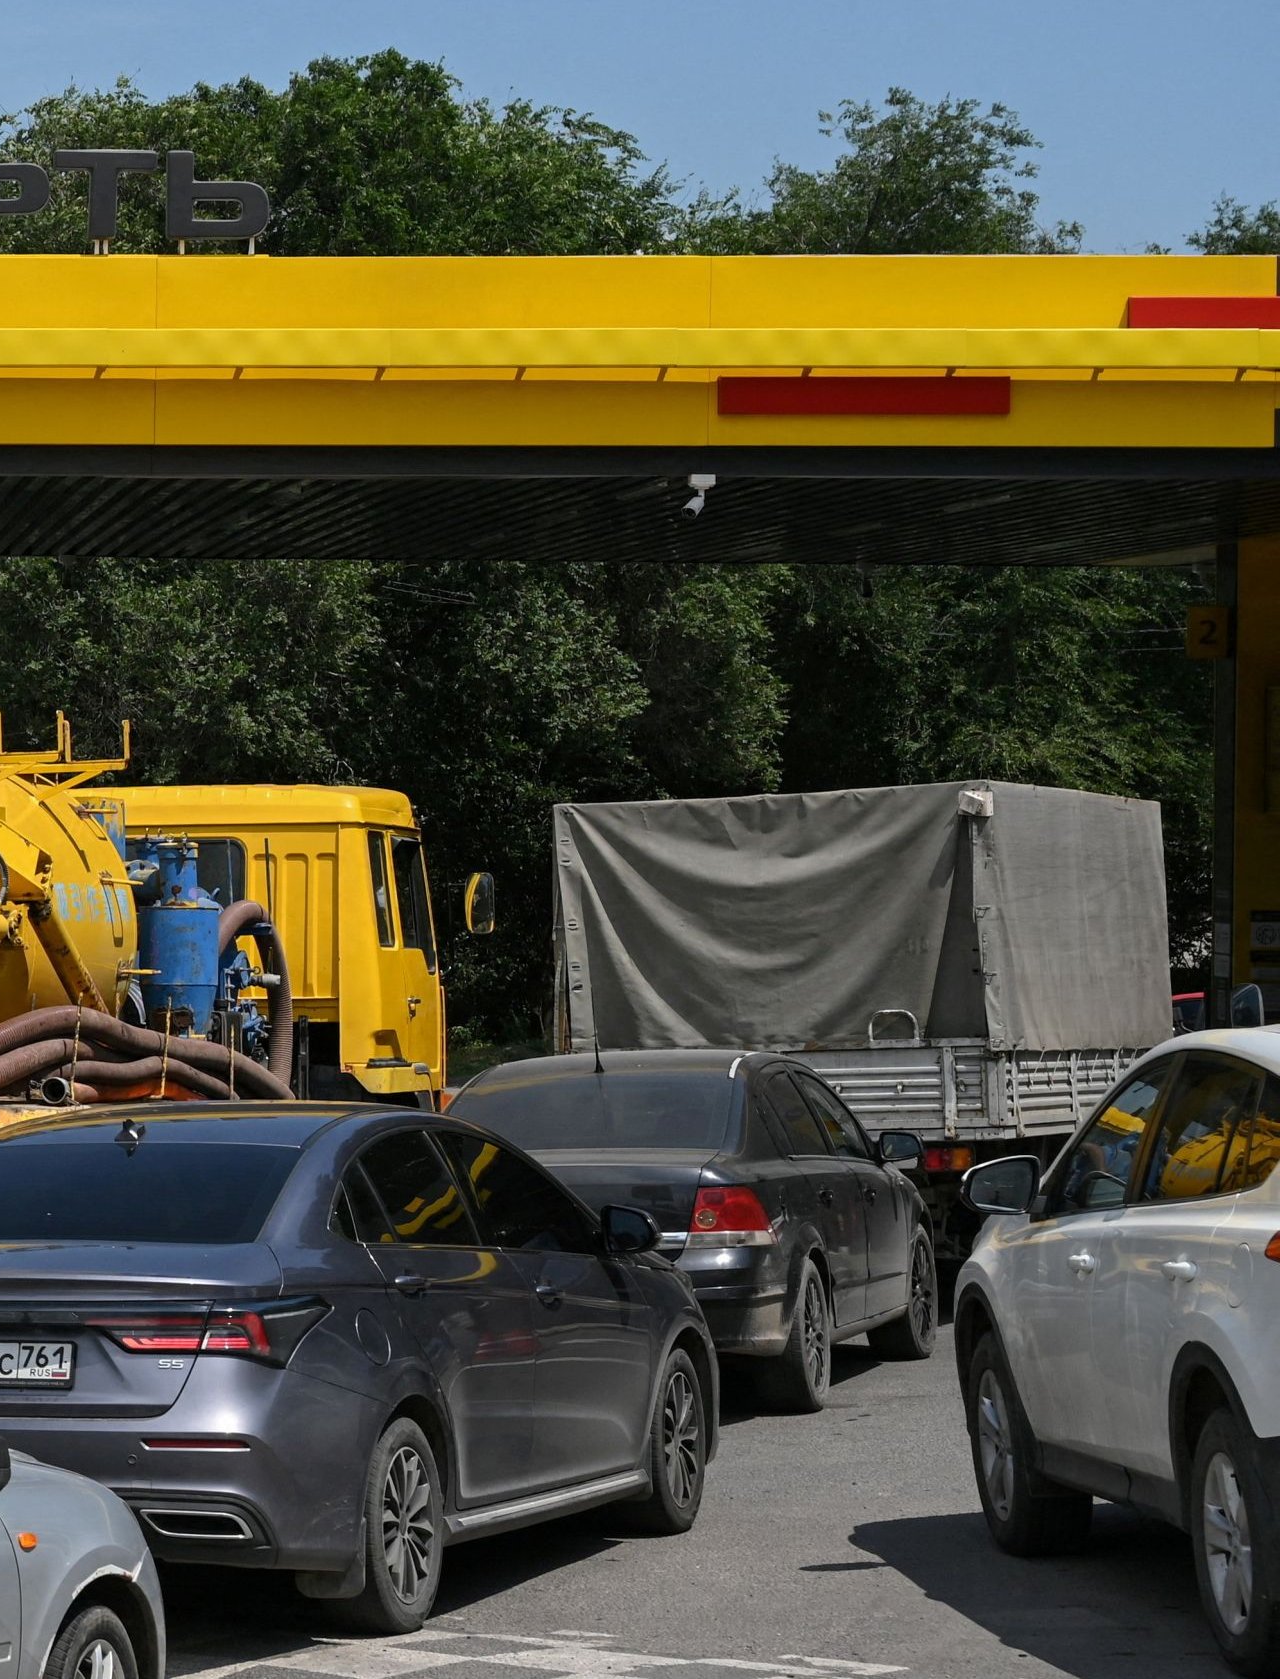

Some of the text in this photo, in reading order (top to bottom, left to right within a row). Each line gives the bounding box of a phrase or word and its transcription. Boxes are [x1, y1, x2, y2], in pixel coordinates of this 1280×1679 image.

[1198, 619, 1217, 645] 2
[21, 1345, 65, 1369] 761
[29, 1368, 51, 1377] RUS
